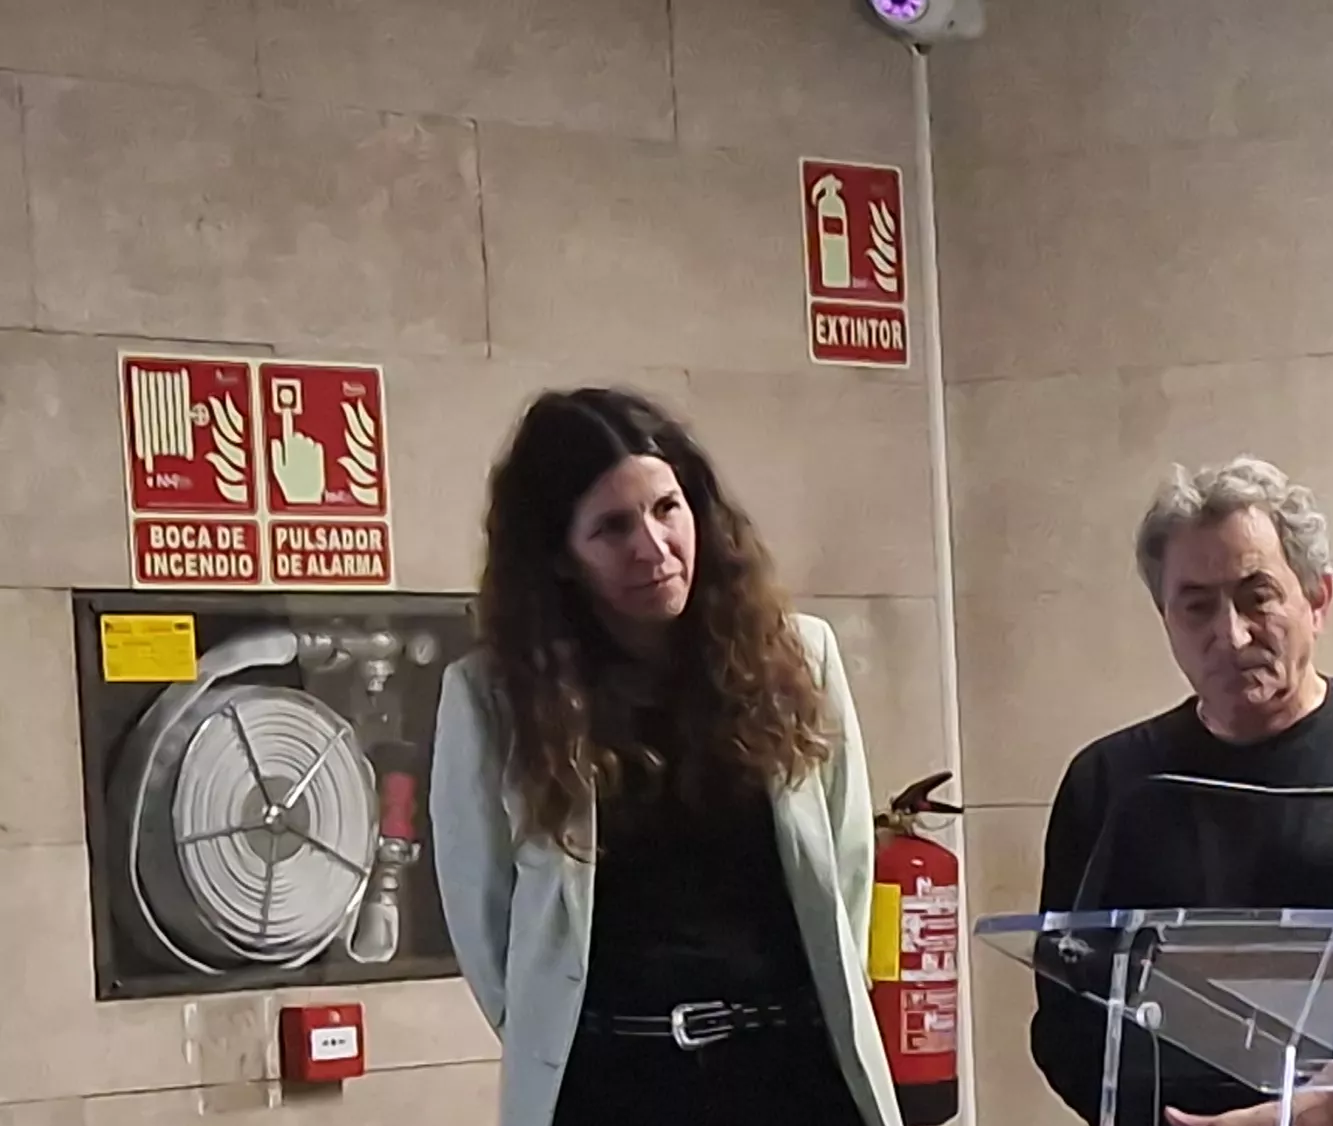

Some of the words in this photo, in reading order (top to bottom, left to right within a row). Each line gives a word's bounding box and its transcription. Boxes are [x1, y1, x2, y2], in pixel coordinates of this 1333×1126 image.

[816, 313, 903, 350] EXTINTOR
[149, 525, 211, 549] BOCA
[217, 526, 245, 549] DE
[276, 527, 383, 551] PULSADOR
[144, 552, 253, 577] INCENDIO
[277, 554, 302, 577] DE
[306, 554, 384, 577] ALARMA
